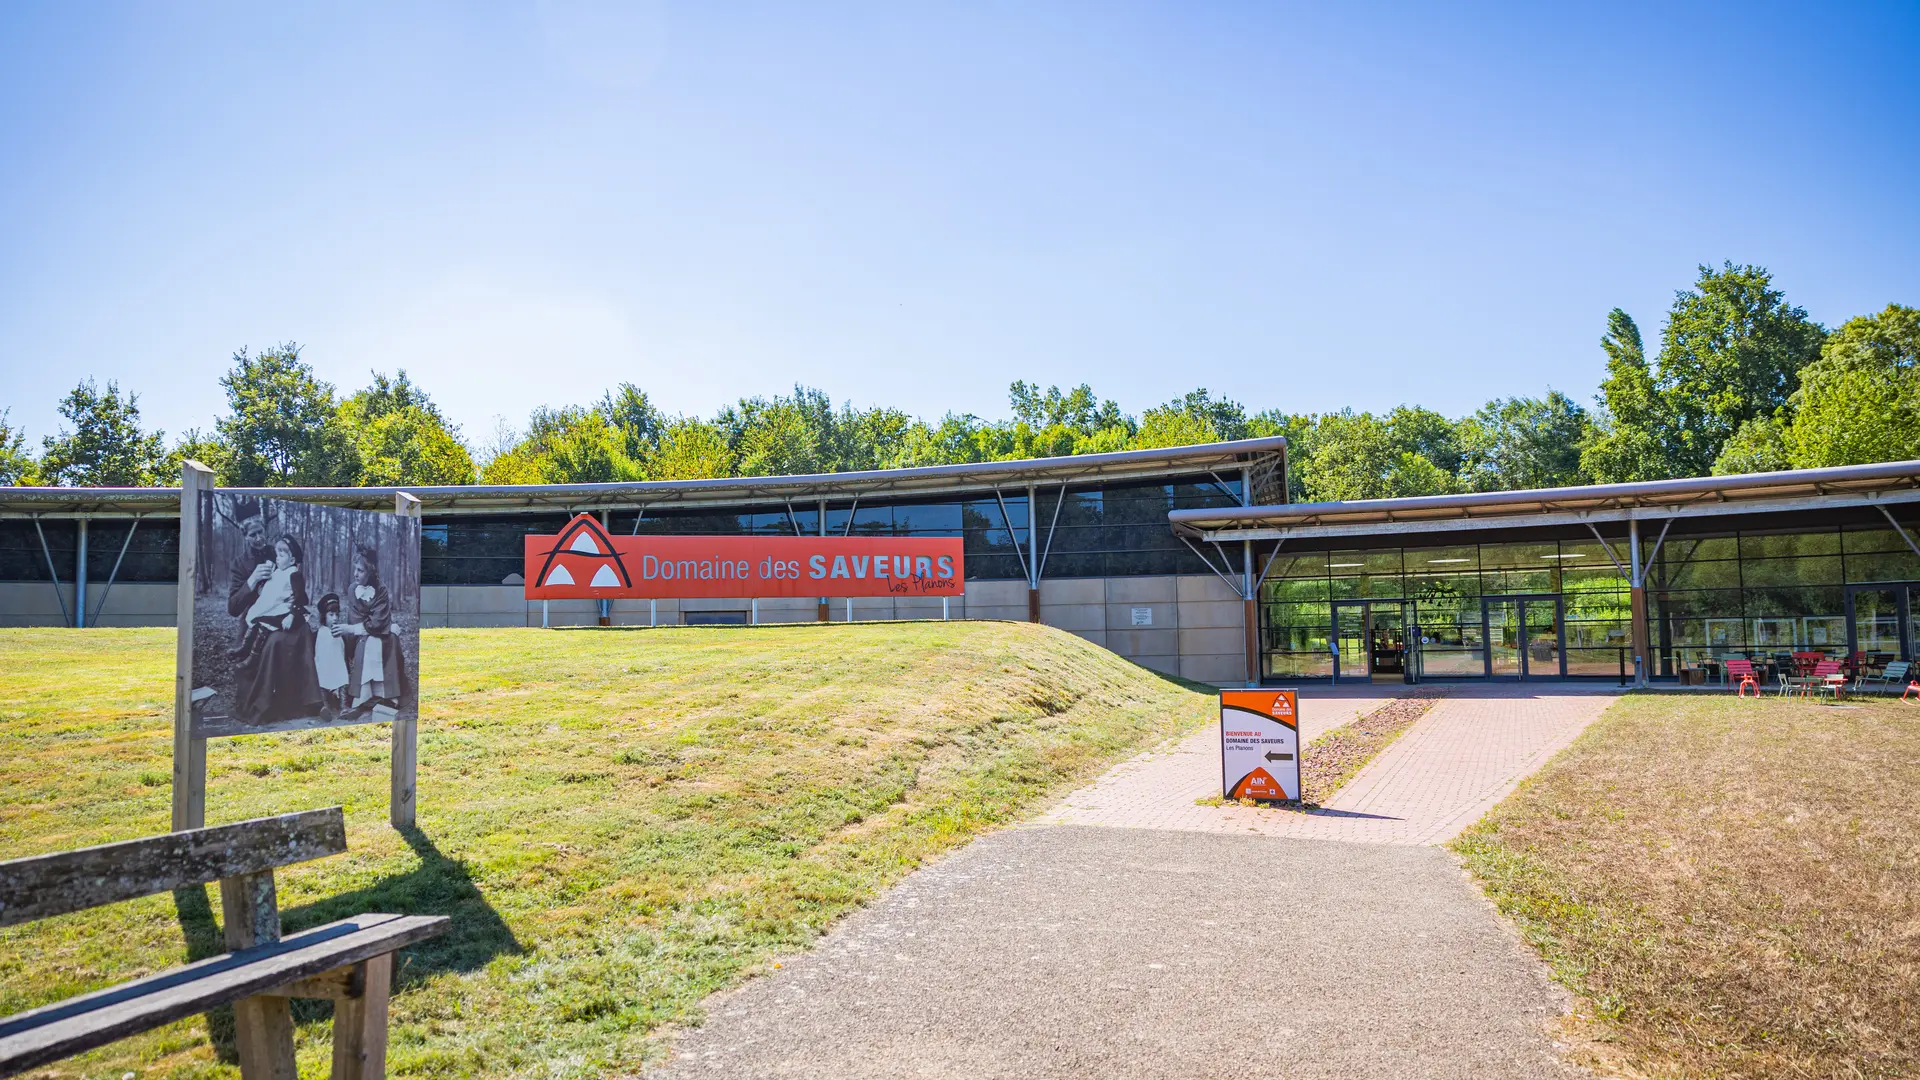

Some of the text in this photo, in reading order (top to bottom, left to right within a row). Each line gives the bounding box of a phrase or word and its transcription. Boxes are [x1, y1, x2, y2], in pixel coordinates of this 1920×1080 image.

[643, 554, 955, 580] Domaine des SAVEURS
[886, 572, 955, 592] Les Planons
[1251, 777, 1265, 785] AIN
